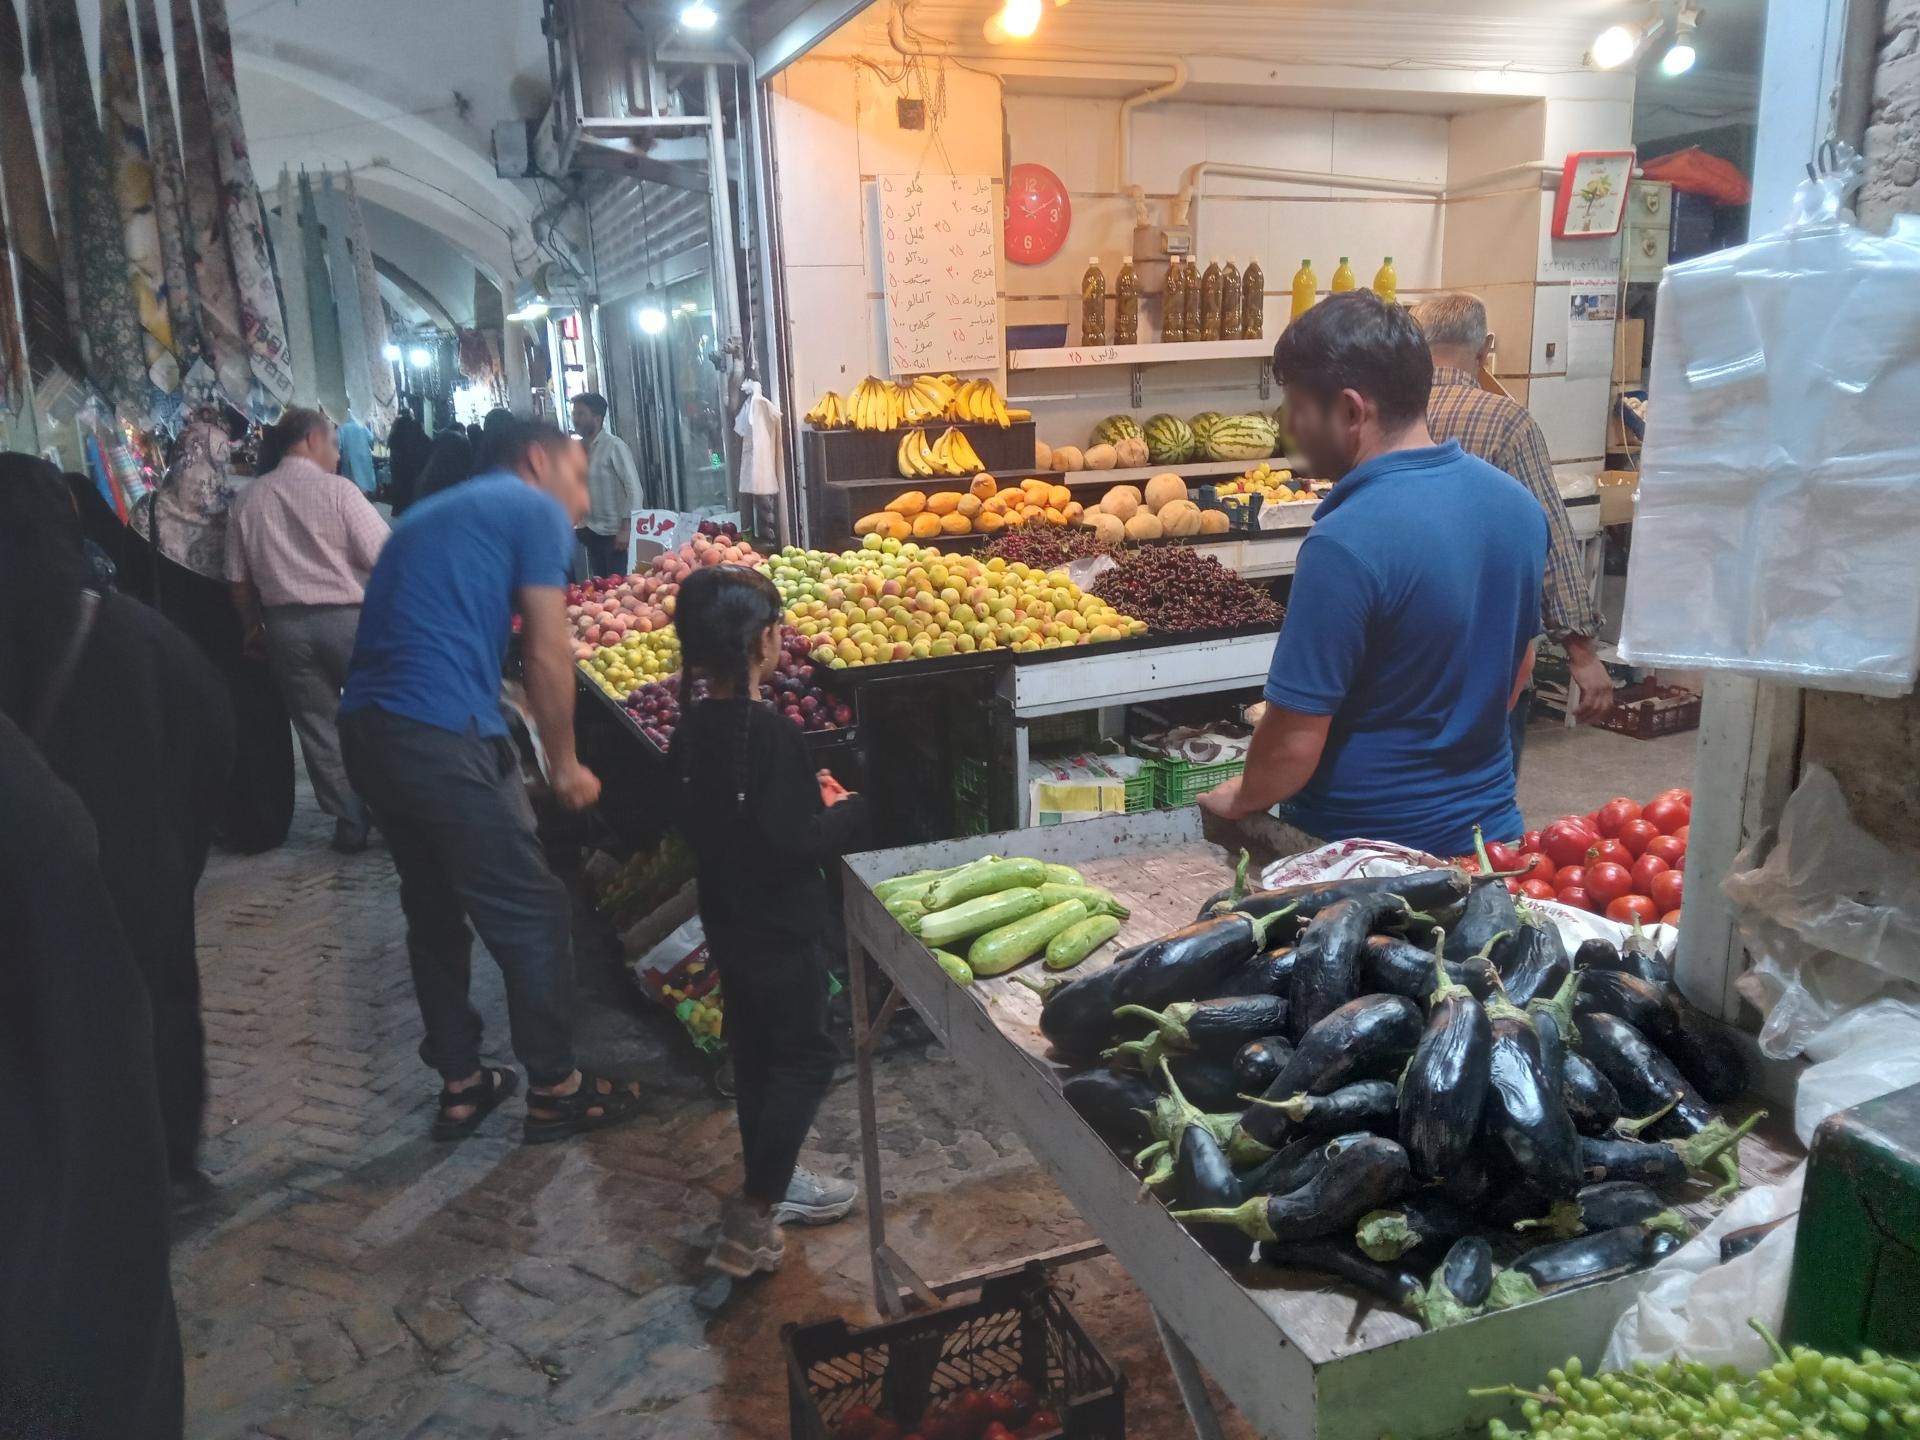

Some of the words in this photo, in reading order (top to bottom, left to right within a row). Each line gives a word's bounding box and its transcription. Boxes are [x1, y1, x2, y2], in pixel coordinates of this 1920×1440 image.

[1025, 177, 1037, 192] 12
[904, 201, 923, 222] آلو
[1050, 209, 1058, 223] 3
[1024, 235, 1032, 249] 6
[971, 267, 994, 285] هویج
[912, 338, 933, 354] موز
[636, 512, 676, 537] حراج
